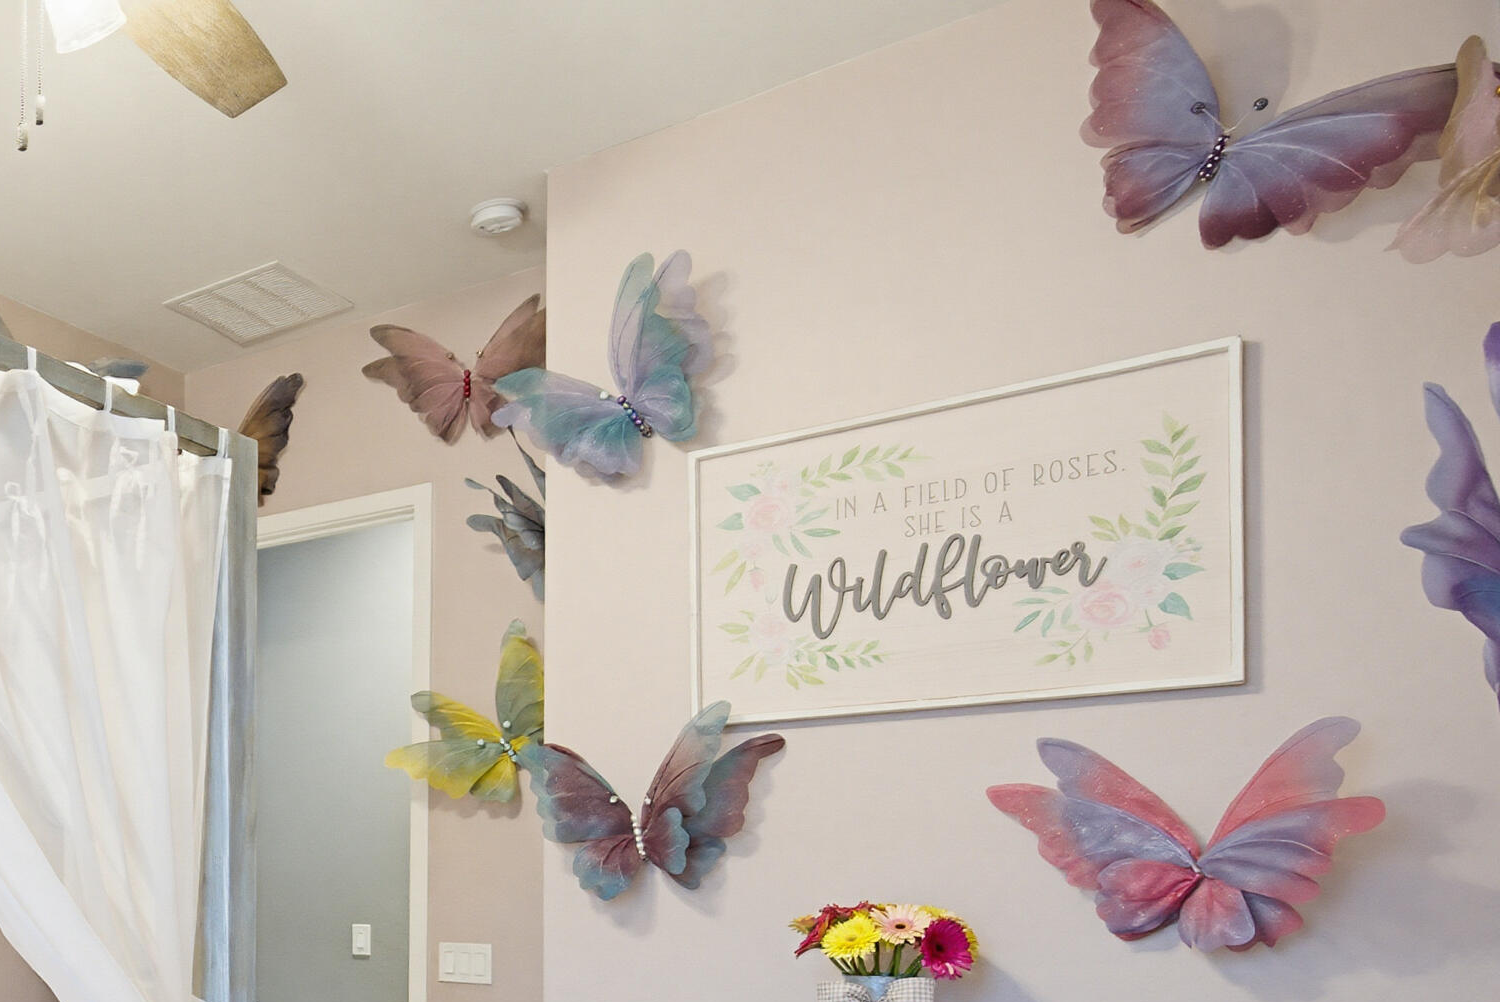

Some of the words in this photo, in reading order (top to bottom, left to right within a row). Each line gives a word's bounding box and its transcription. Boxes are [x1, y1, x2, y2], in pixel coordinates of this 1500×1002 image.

[835, 495, 857, 521] IN
[872, 491, 888, 514] A
[903, 477, 968, 509] FIELD
[983, 467, 1015, 494] OF
[903, 510, 946, 538] SHE
[961, 504, 982, 530] IS
[998, 500, 1014, 523] A
[782, 533, 1108, 640] Wildflower
